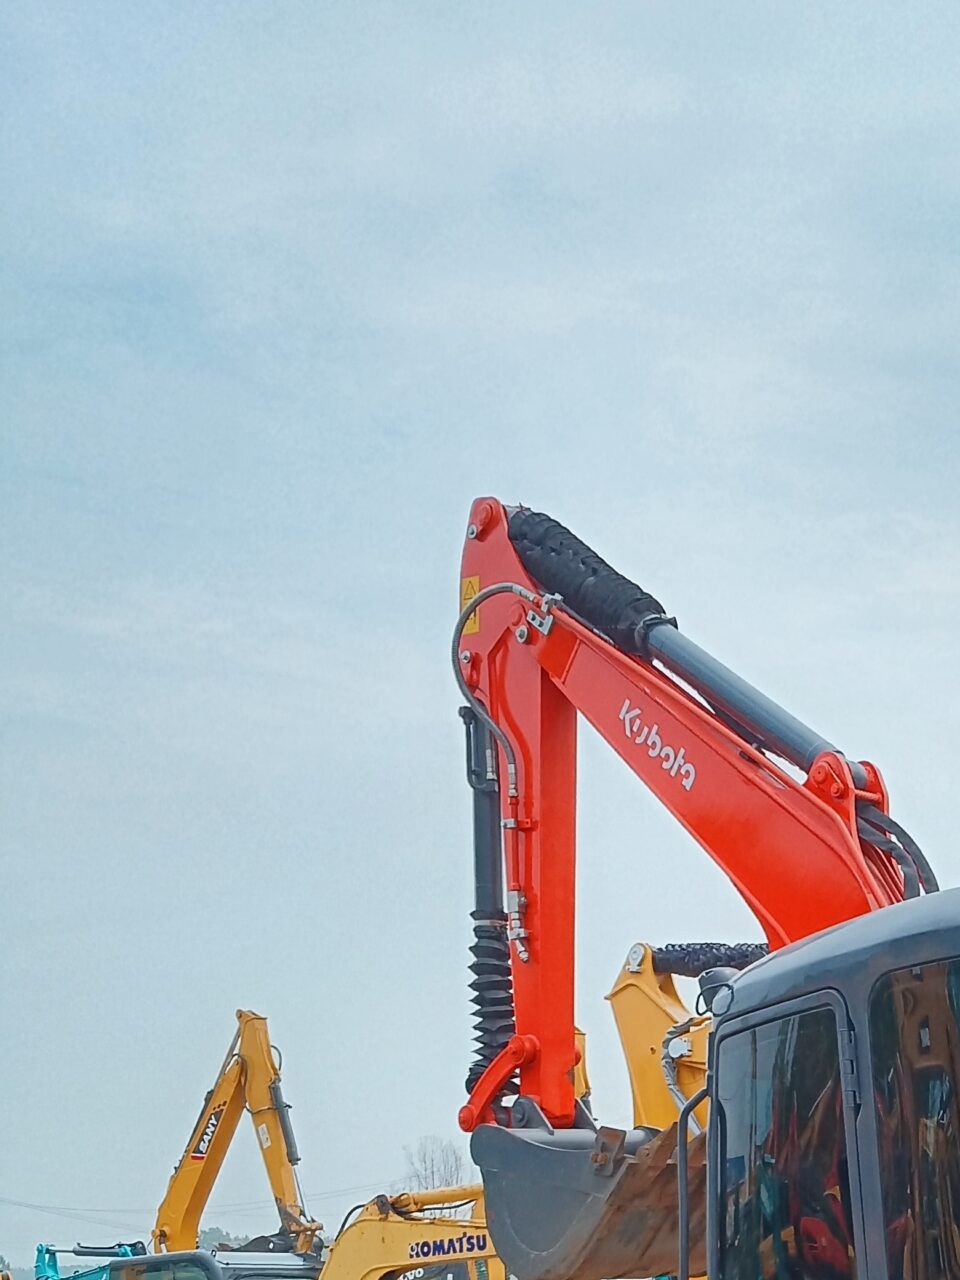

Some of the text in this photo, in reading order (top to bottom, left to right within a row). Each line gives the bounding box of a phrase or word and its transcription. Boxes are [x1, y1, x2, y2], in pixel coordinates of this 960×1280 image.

[618, 698, 696, 791] Kubota
[199, 1114, 217, 1153] SANY
[409, 1232, 487, 1258] KOMATSU
